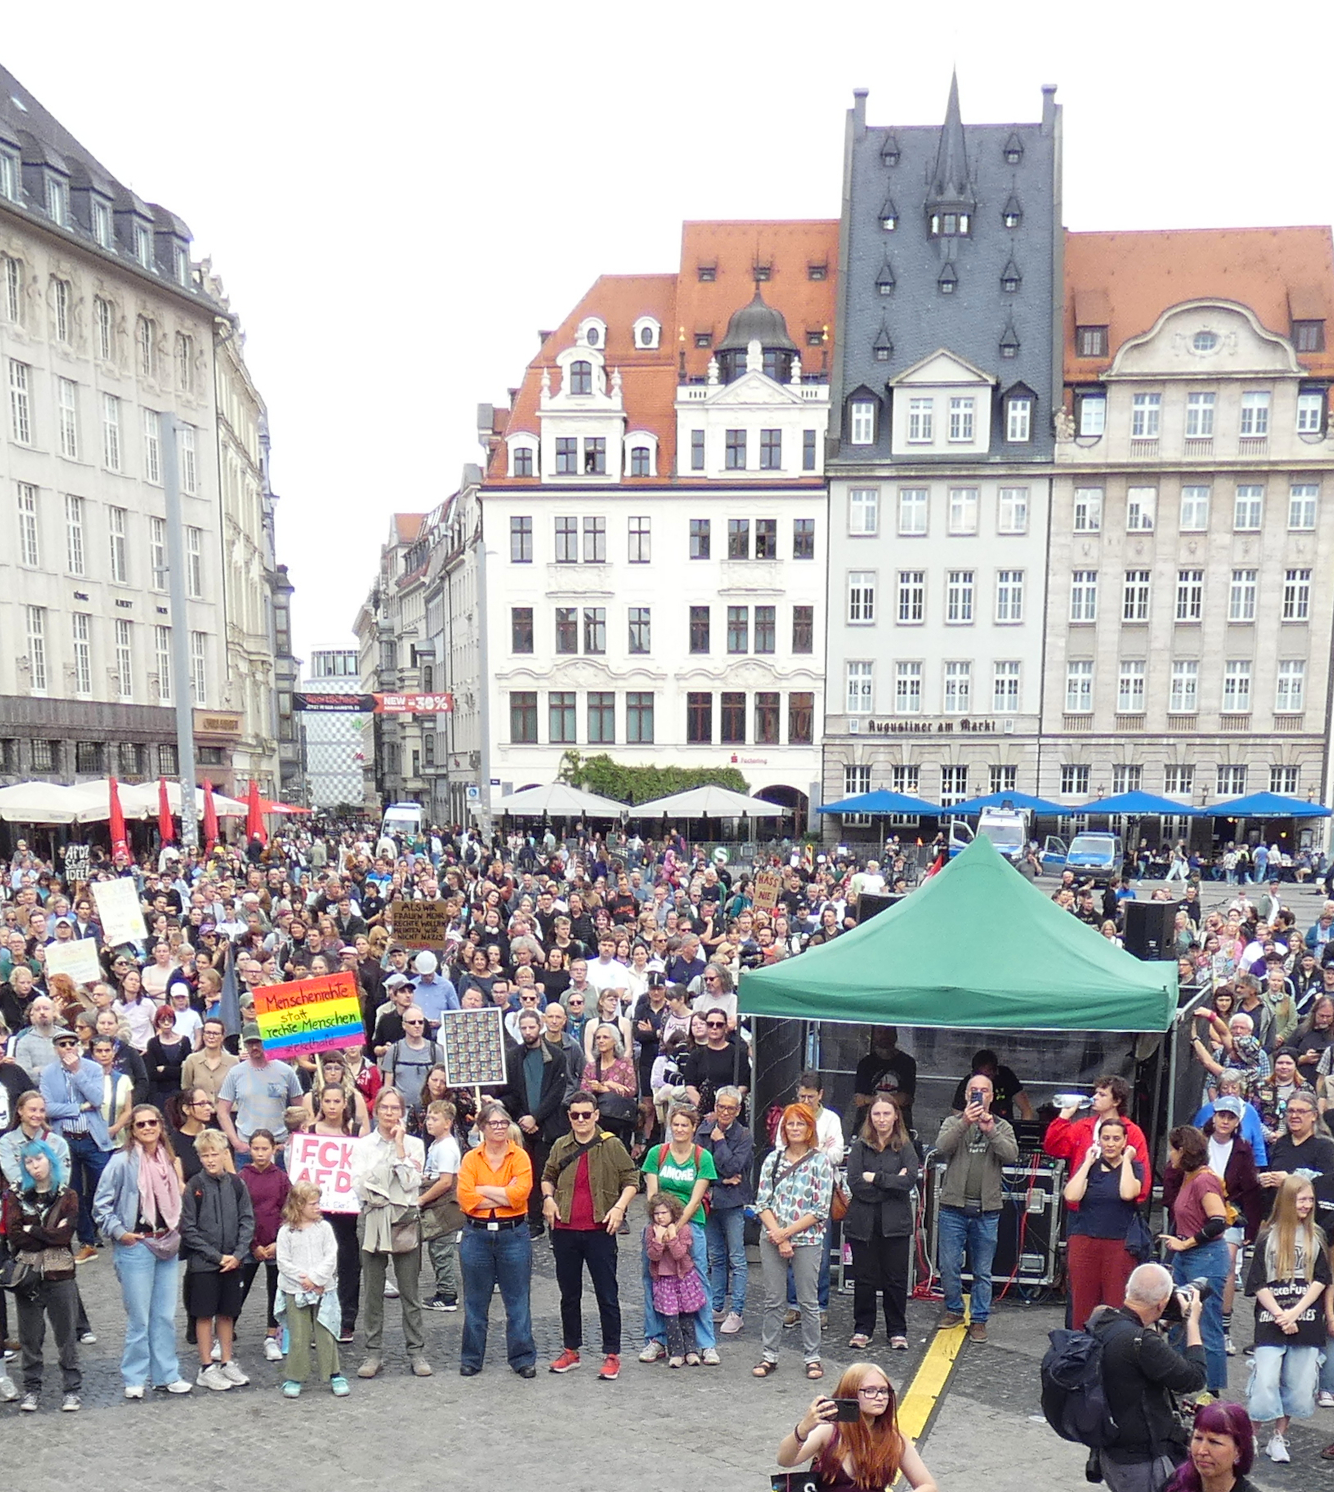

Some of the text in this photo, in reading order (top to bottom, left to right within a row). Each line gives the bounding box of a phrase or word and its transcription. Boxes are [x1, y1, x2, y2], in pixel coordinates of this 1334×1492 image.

[383, 696, 406, 706] NEW
[868, 718, 996, 734] Augustiner am Markt
[280, 1008, 308, 1023] statt
[266, 1010, 357, 1039] rechte Menschen
[299, 1138, 354, 1170] FCK
[658, 1165, 695, 1182] AMORE
